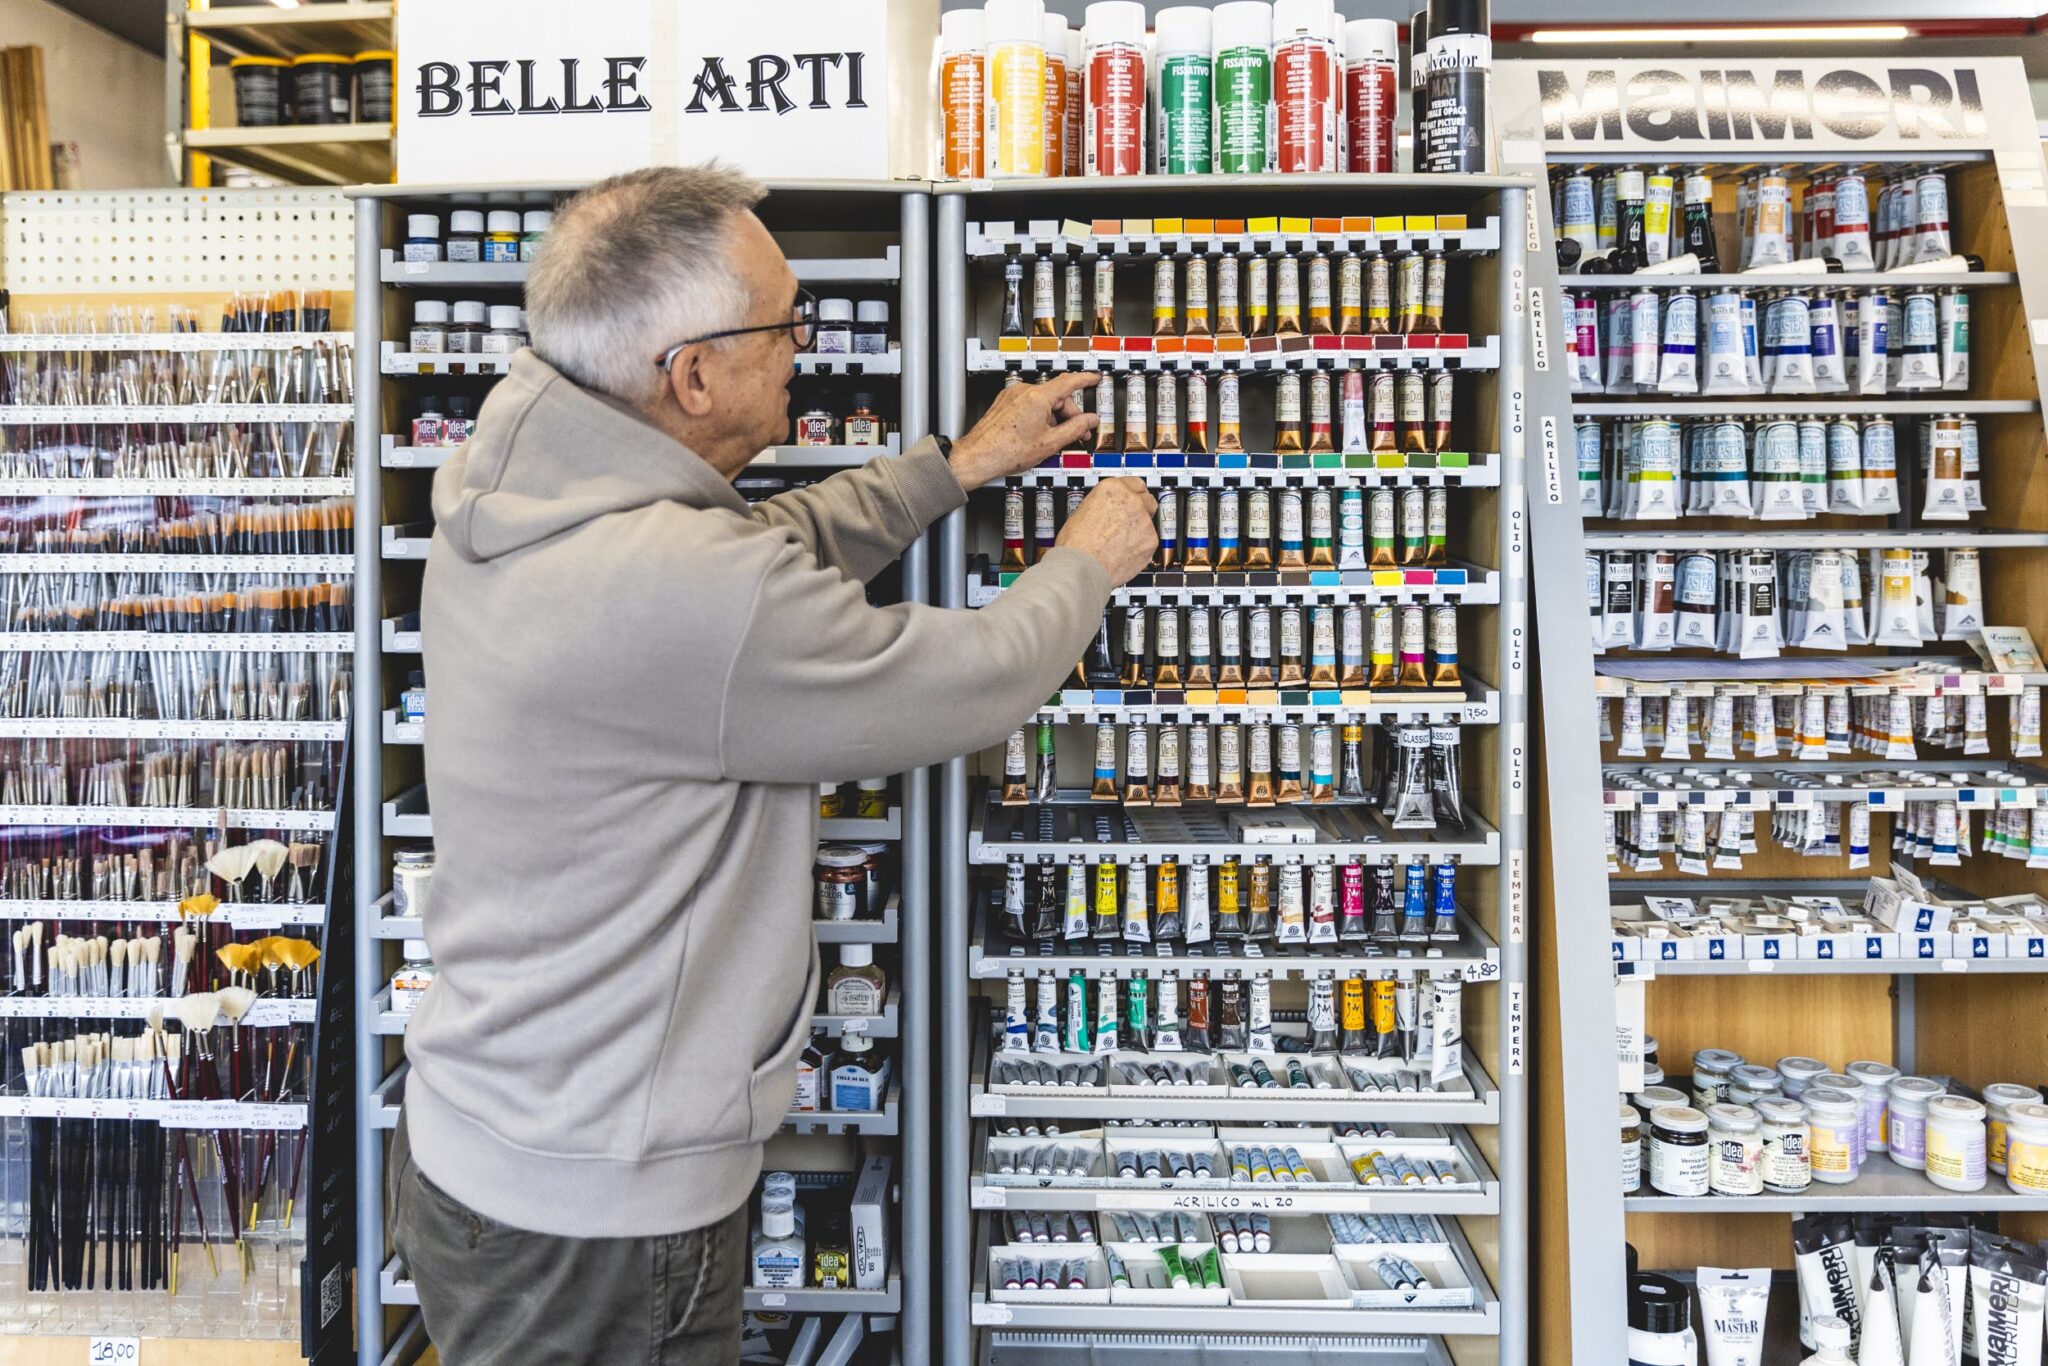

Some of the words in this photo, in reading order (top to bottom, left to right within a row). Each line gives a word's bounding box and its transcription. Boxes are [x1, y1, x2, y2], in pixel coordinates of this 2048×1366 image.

[1172, 66, 1209, 76] FISSATIVO
[1223, 57, 1262, 69] FISSATIVO
[416, 57, 653, 117] BELLE
[684, 52, 868, 116] ARTI
[1432, 77, 1456, 97] MAT
[1431, 98, 1456, 109] VERNICE
[1443, 106, 1467, 116] OPACA
[1513, 270, 1522, 312] OLIO
[1532, 290, 1546, 369] ACRILICO
[1513, 392, 1522, 433] OLIO
[419, 421, 436, 433] idea
[448, 421, 466, 433] idea
[807, 419, 826, 432] idea
[852, 419, 871, 432] idea
[1544, 420, 1559, 502] ACRILICO
[1512, 511, 1521, 553] OLIO
[1513, 628, 1521, 671] OLIO
[1466, 708, 1488, 720] 7,50
[1513, 747, 1521, 790] OLIO
[1512, 858, 1521, 935] TEMPERA
[1467, 962, 1498, 979] 4,80
[1512, 992, 1521, 1068] TEMPERA
[1722, 1141, 1743, 1160] idea
[1783, 1136, 1802, 1150] idea
[1174, 1196, 1240, 1208] ACRILICO
[1252, 1197, 1269, 1208] ml
[821, 1254, 839, 1267] idea
[1714, 1319, 1759, 1334] MASTER
[92, 1342, 135, 1364] 18,00
